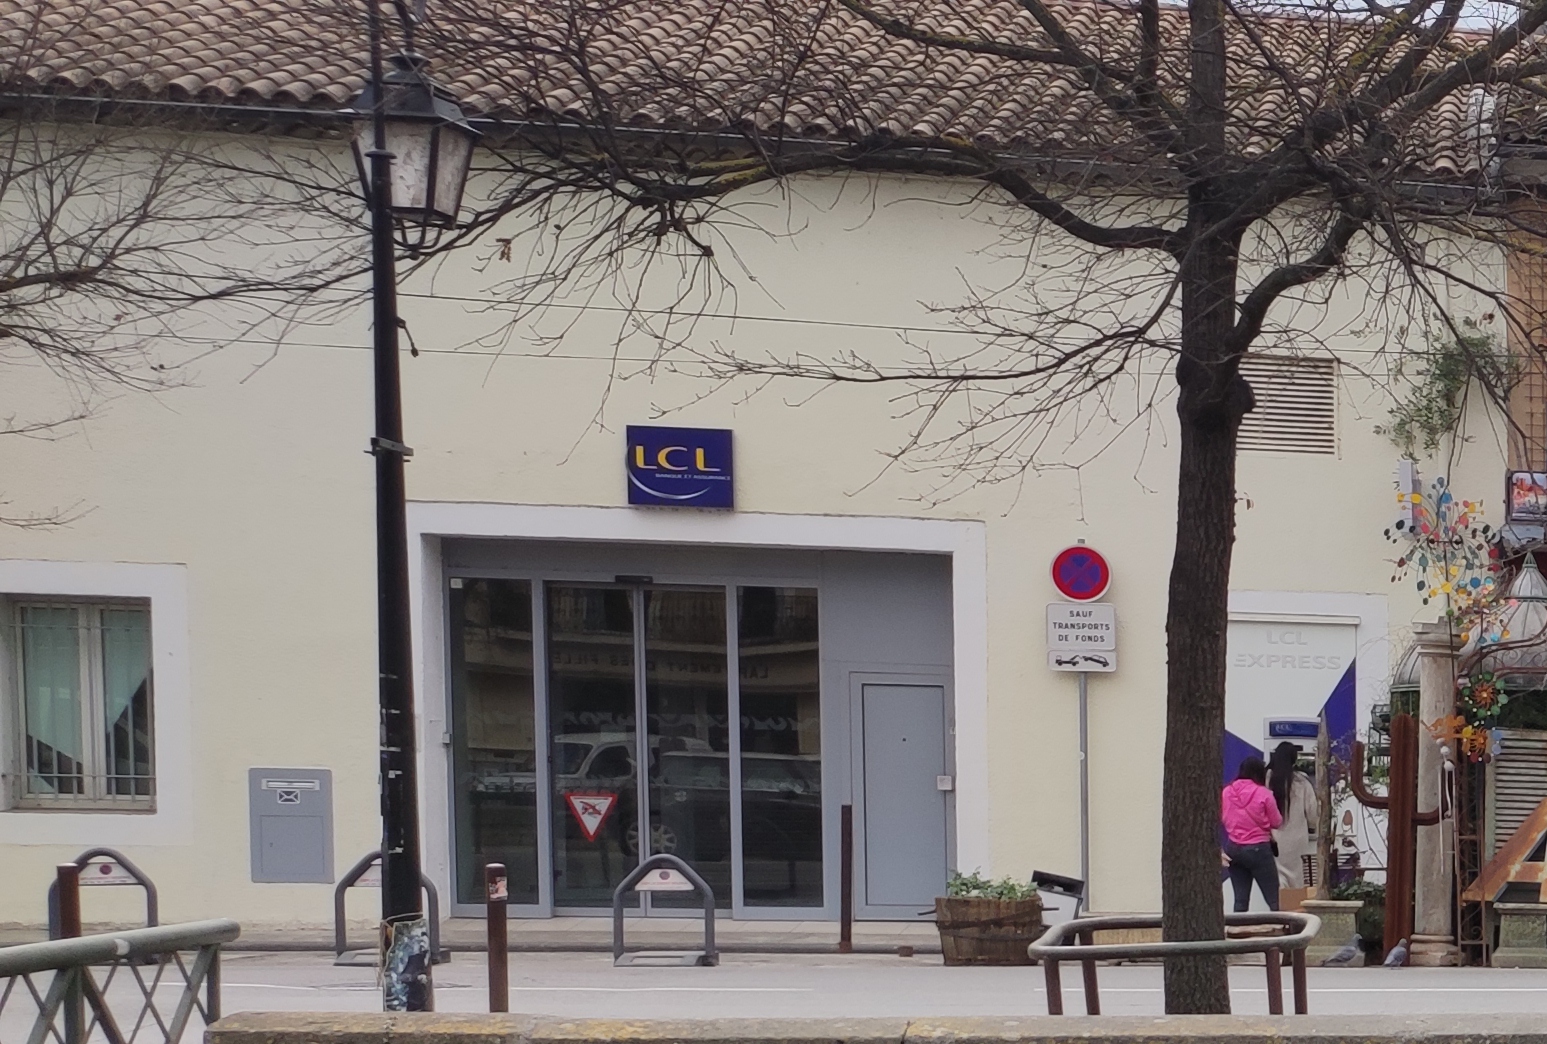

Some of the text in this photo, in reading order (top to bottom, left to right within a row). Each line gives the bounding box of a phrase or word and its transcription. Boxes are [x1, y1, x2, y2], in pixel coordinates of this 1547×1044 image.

[635, 445, 721, 472] LCL
[1069, 610, 1093, 618] SAUF
[1053, 622, 1110, 631] TRANSPORTS
[1058, 634, 1069, 642] DE
[1266, 630, 1308, 646] LCL
[1233, 654, 1341, 670] EXPRESS
